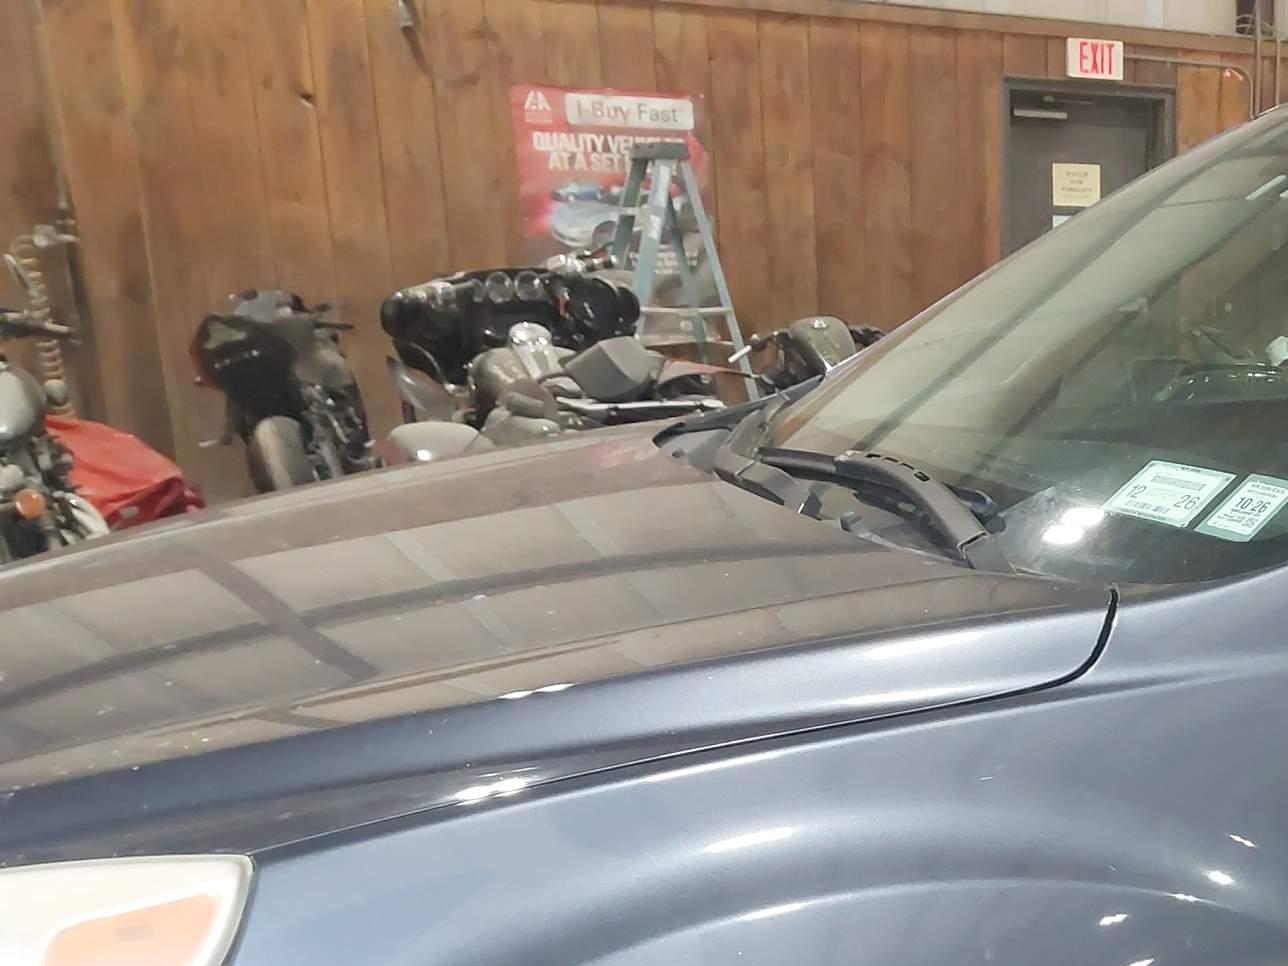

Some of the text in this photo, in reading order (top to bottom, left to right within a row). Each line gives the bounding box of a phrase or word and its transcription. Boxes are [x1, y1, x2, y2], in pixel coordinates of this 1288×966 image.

[1079, 40, 1115, 75] EXIT
[576, 100, 630, 123] I-Buy
[637, 103, 679, 123] Fast
[532, 131, 606, 153] QUALITY
[548, 152, 573, 171] AT
[574, 153, 587, 171] A
[590, 154, 622, 171] SET
[1126, 483, 1148, 499] 12
[1172, 494, 1201, 511] 26
